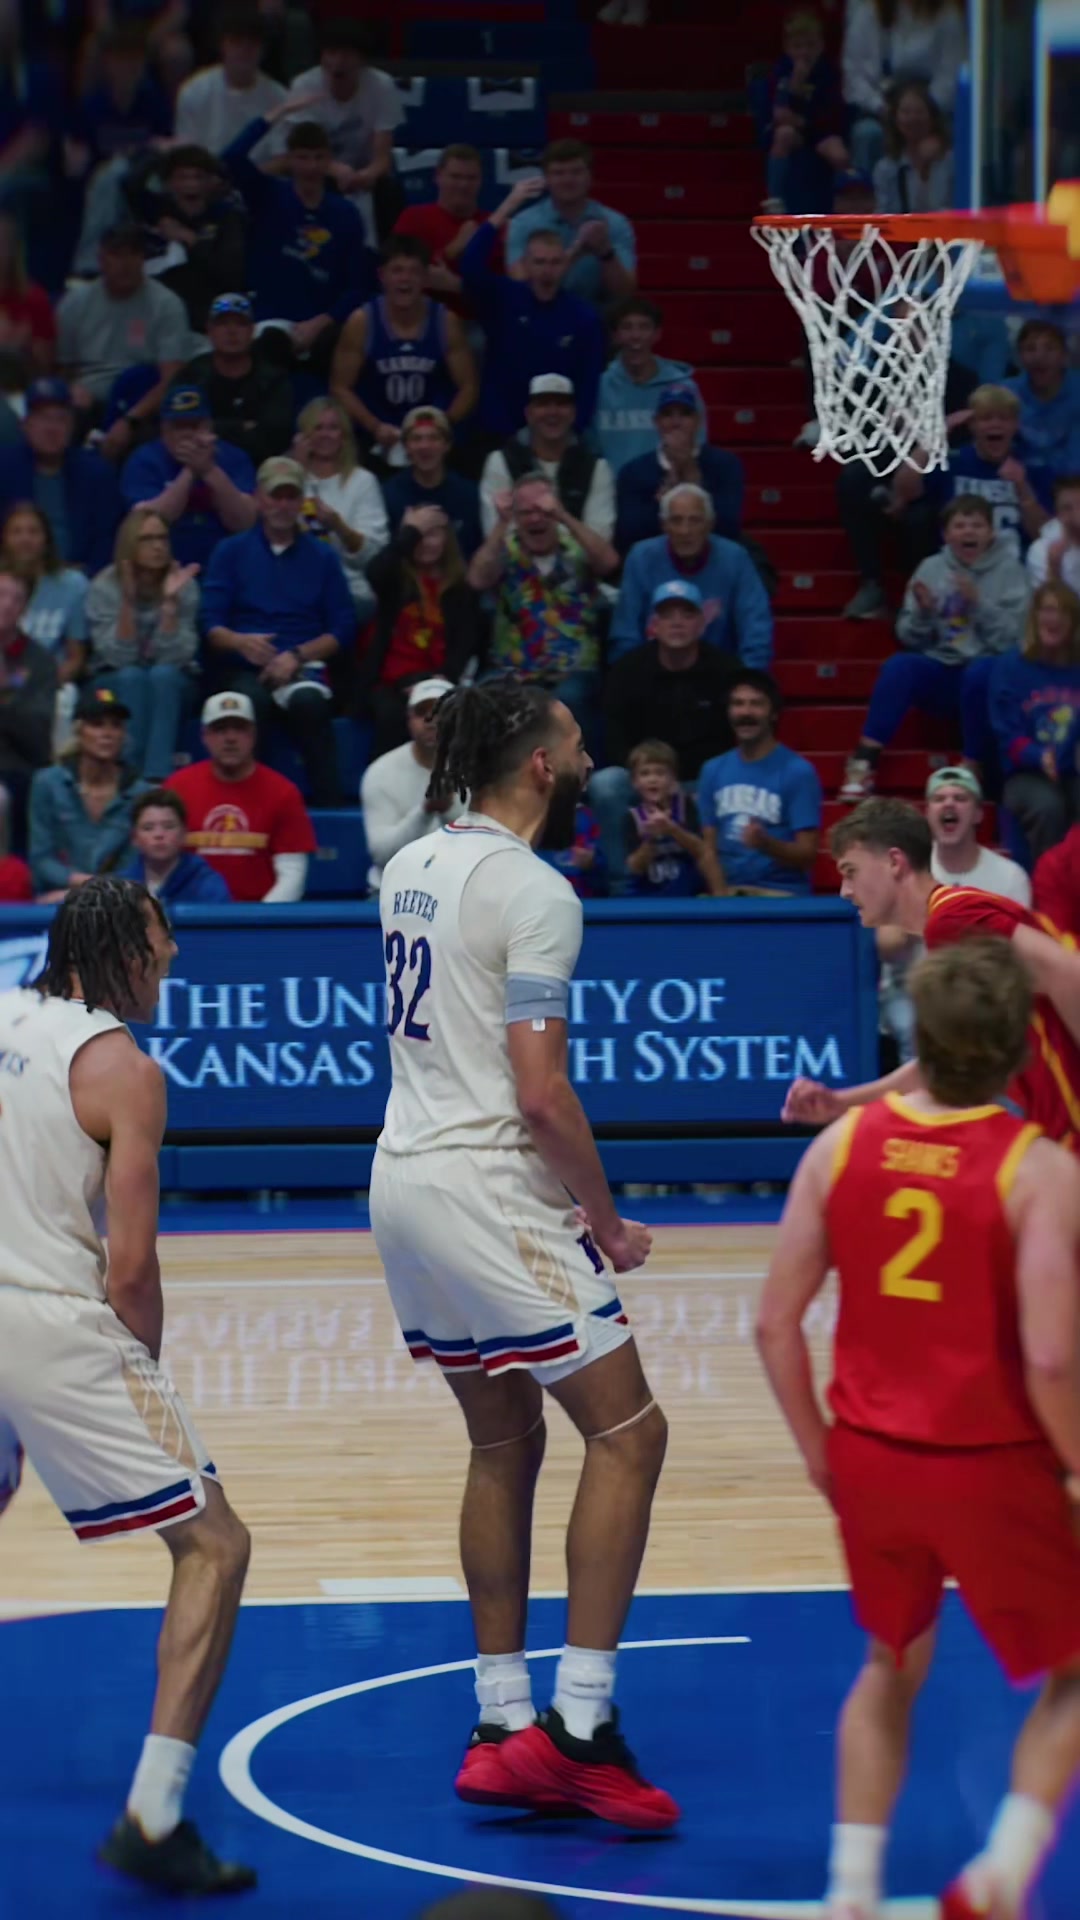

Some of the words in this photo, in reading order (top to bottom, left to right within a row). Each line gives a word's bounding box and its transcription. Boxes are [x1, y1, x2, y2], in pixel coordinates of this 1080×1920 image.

[392, 888, 439, 923] REEVES
[154, 977, 267, 1029] THE
[648, 977, 726, 1023] OF
[385, 929, 432, 1042] 32
[146, 1036, 375, 1088] KANSAS
[633, 1030, 847, 1082] SYSTEM
[878, 1187, 944, 1303] 2
